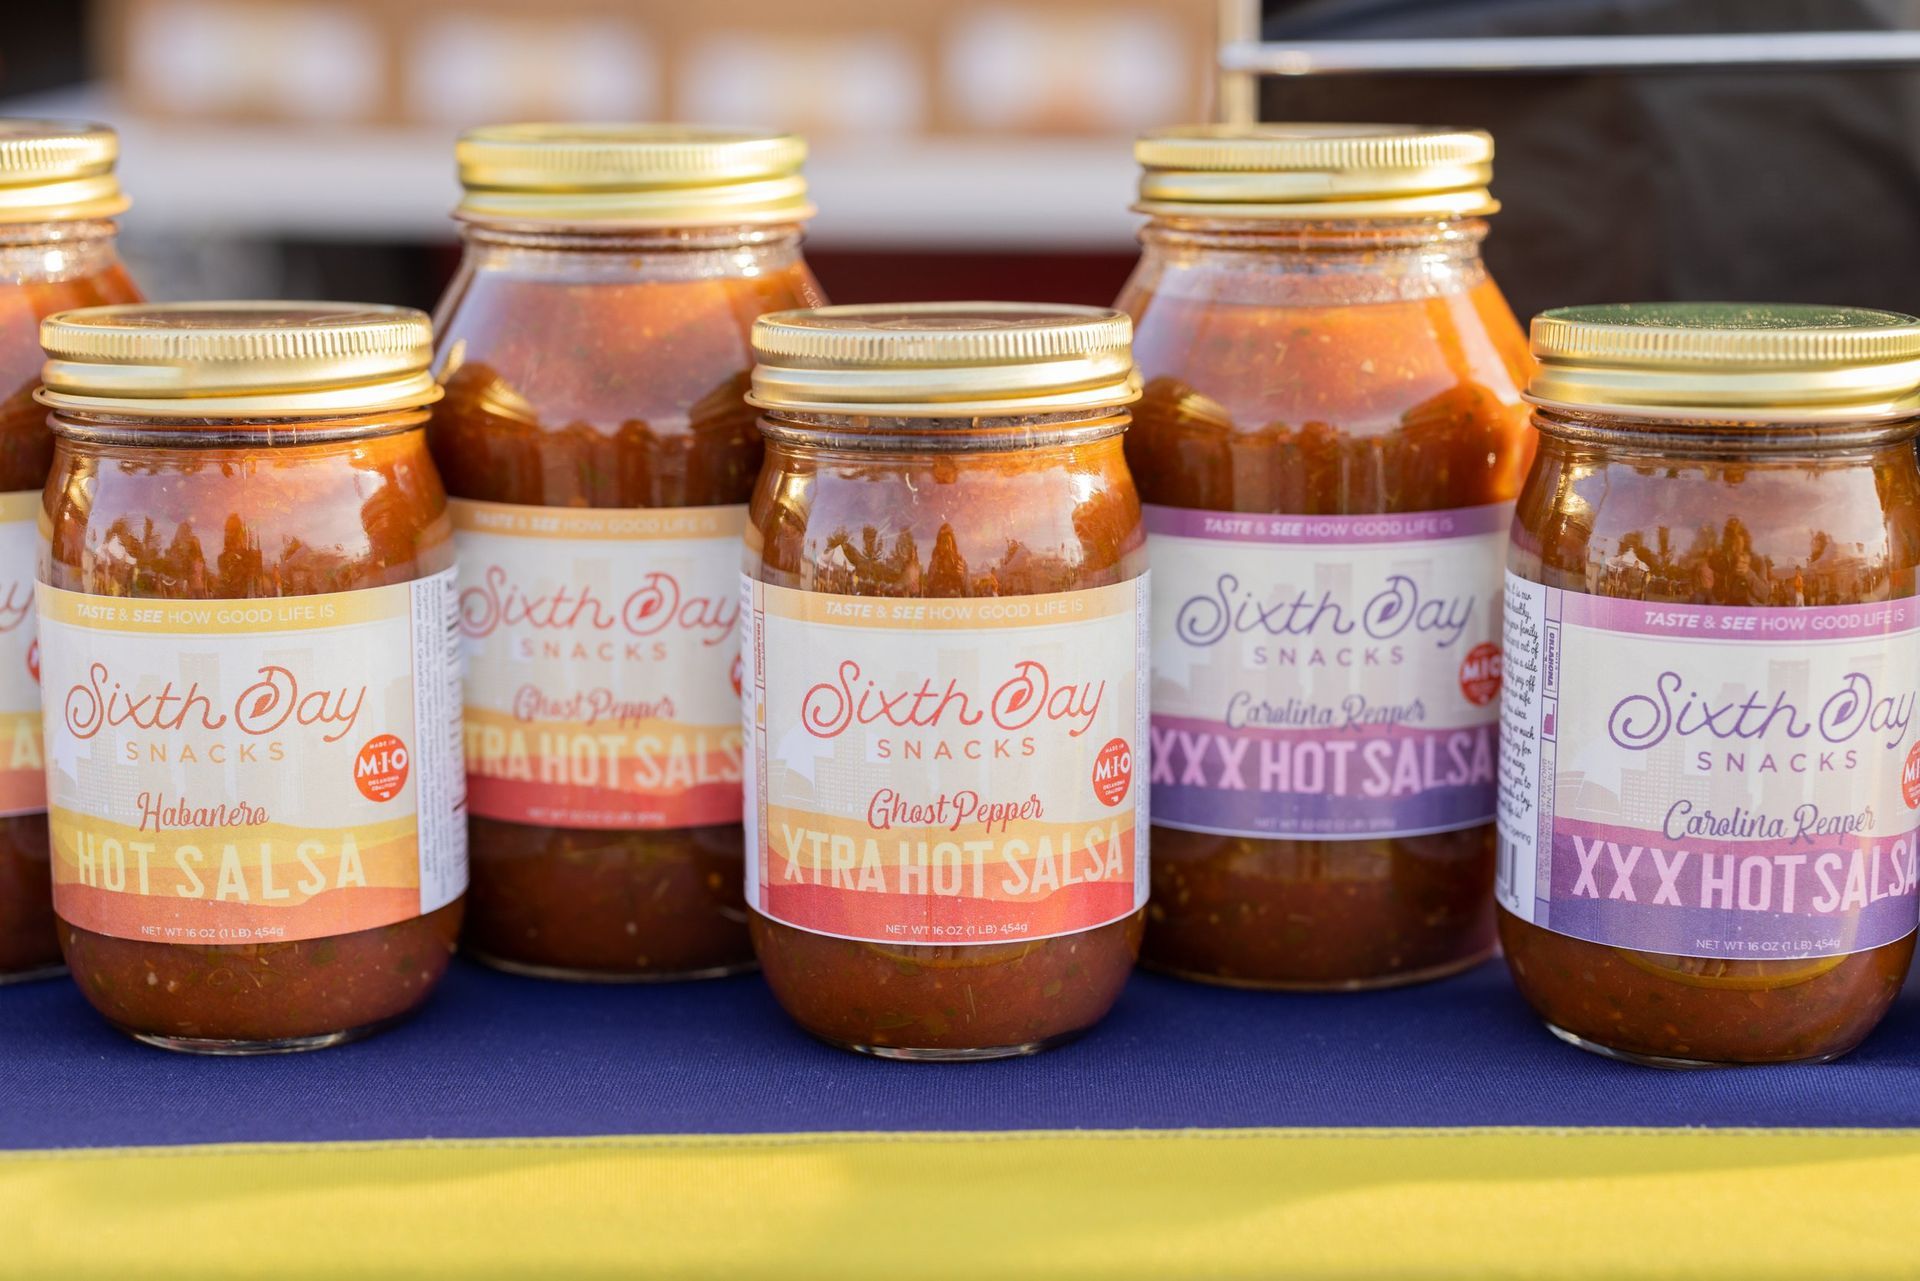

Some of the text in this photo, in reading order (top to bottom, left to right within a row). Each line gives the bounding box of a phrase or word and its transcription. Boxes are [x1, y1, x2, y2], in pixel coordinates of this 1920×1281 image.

[563, 517, 603, 531] HOW
[607, 516, 660, 532] GOOD
[664, 515, 698, 531] LIFE
[1204, 518, 1453, 537] TASTE & SEE HOW GOOD LIFE IS
[77, 603, 335, 624] TASTE & SEE HOW GOOD LIFE IS
[459, 565, 741, 645] Sixth Day
[825, 599, 1083, 620] TASTE & SEE HOW GOOD LIFE IS
[1177, 574, 1475, 648] Sixth Day
[1644, 608, 1905, 631] TASTE & SEE HOW GOOD LIFE IS
[522, 638, 668, 662] SNACKS
[1254, 646, 1404, 666] SNACKS
[1547, 632, 1555, 686] OKLAHOMA
[65, 662, 367, 742] Sixth Day
[801, 660, 983, 739] Sixth
[991, 660, 1105, 737] Day
[1225, 691, 1426, 734] Carolina Reaper
[1608, 671, 1916, 750] Sixth Day
[125, 741, 285, 764] SNACKS
[463, 722, 743, 790] TRA HOT SALS
[877, 736, 1036, 760] SNACKS
[1259, 738, 1355, 796] HOT
[1362, 729, 1494, 799] SALSA
[1697, 750, 1857, 773] SNACKS
[137, 792, 270, 832] Habanero
[867, 789, 1044, 834] Ghost Pepper
[1664, 799, 1876, 845] Carolina Reaper
[77, 831, 367, 900] HOT SALSA
[782, 823, 1124, 897] XTRA HOT SALSA
[1701, 854, 1807, 914] HOT
[1813, 832, 1917, 912] SALSA
[141, 925, 161, 936] NET
[165, 926, 182, 937] WT
[185, 926, 197, 938] 16
[200, 927, 216, 938] OZ
[229, 926, 251, 939] LB)
[254, 925, 284, 938] 454g
[886, 923, 907, 935] NET
[911, 924, 930, 936] WT
[932, 925, 943, 936] 16
[946, 925, 963, 936] OZ
[977, 924, 997, 938] LB)
[1000, 922, 1028, 936] 454g
[1696, 939, 1720, 950] NET
[1723, 940, 1744, 951] WT
[1748, 941, 1759, 951] 16
[1762, 941, 1778, 951] OZ
[1793, 939, 1812, 952] LB)
[1815, 938, 1841, 952] 454g
